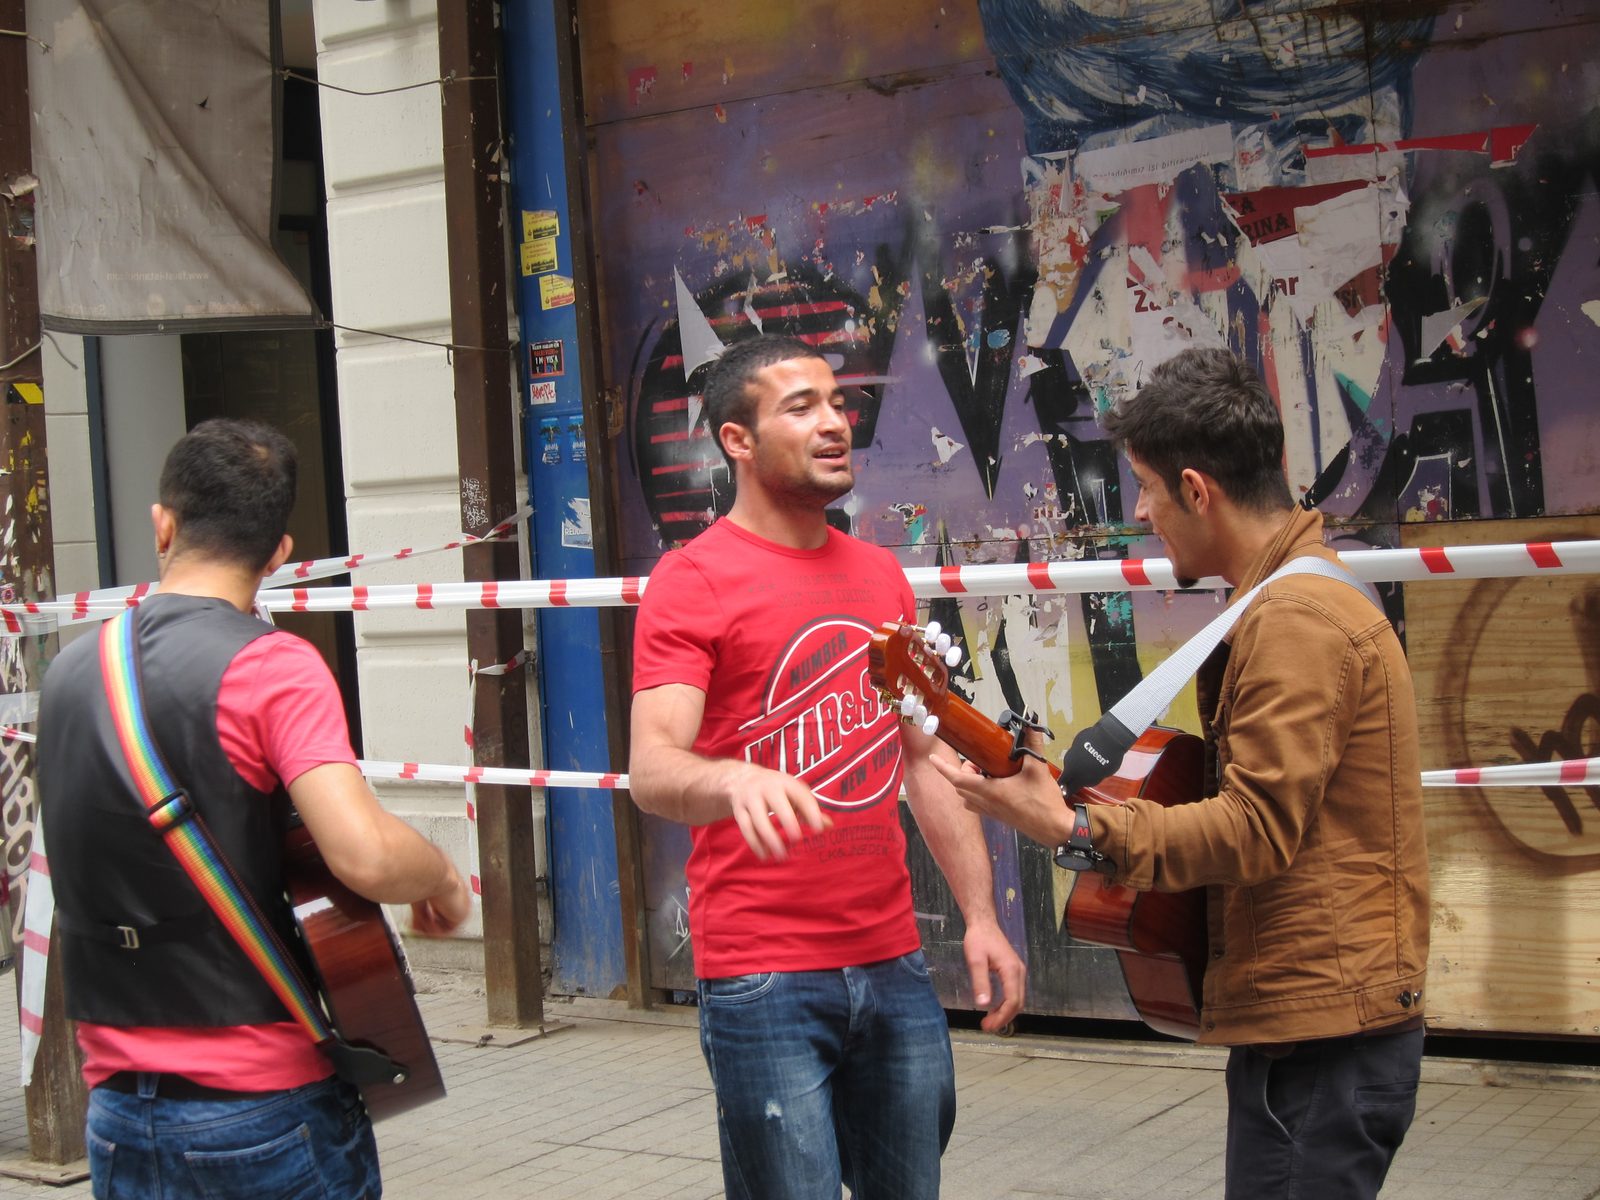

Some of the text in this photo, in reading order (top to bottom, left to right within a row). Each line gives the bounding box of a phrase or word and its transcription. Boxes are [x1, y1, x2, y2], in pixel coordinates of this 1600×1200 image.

[789, 630, 848, 690] NUMBER
[840, 735, 899, 797] NEW YORK
